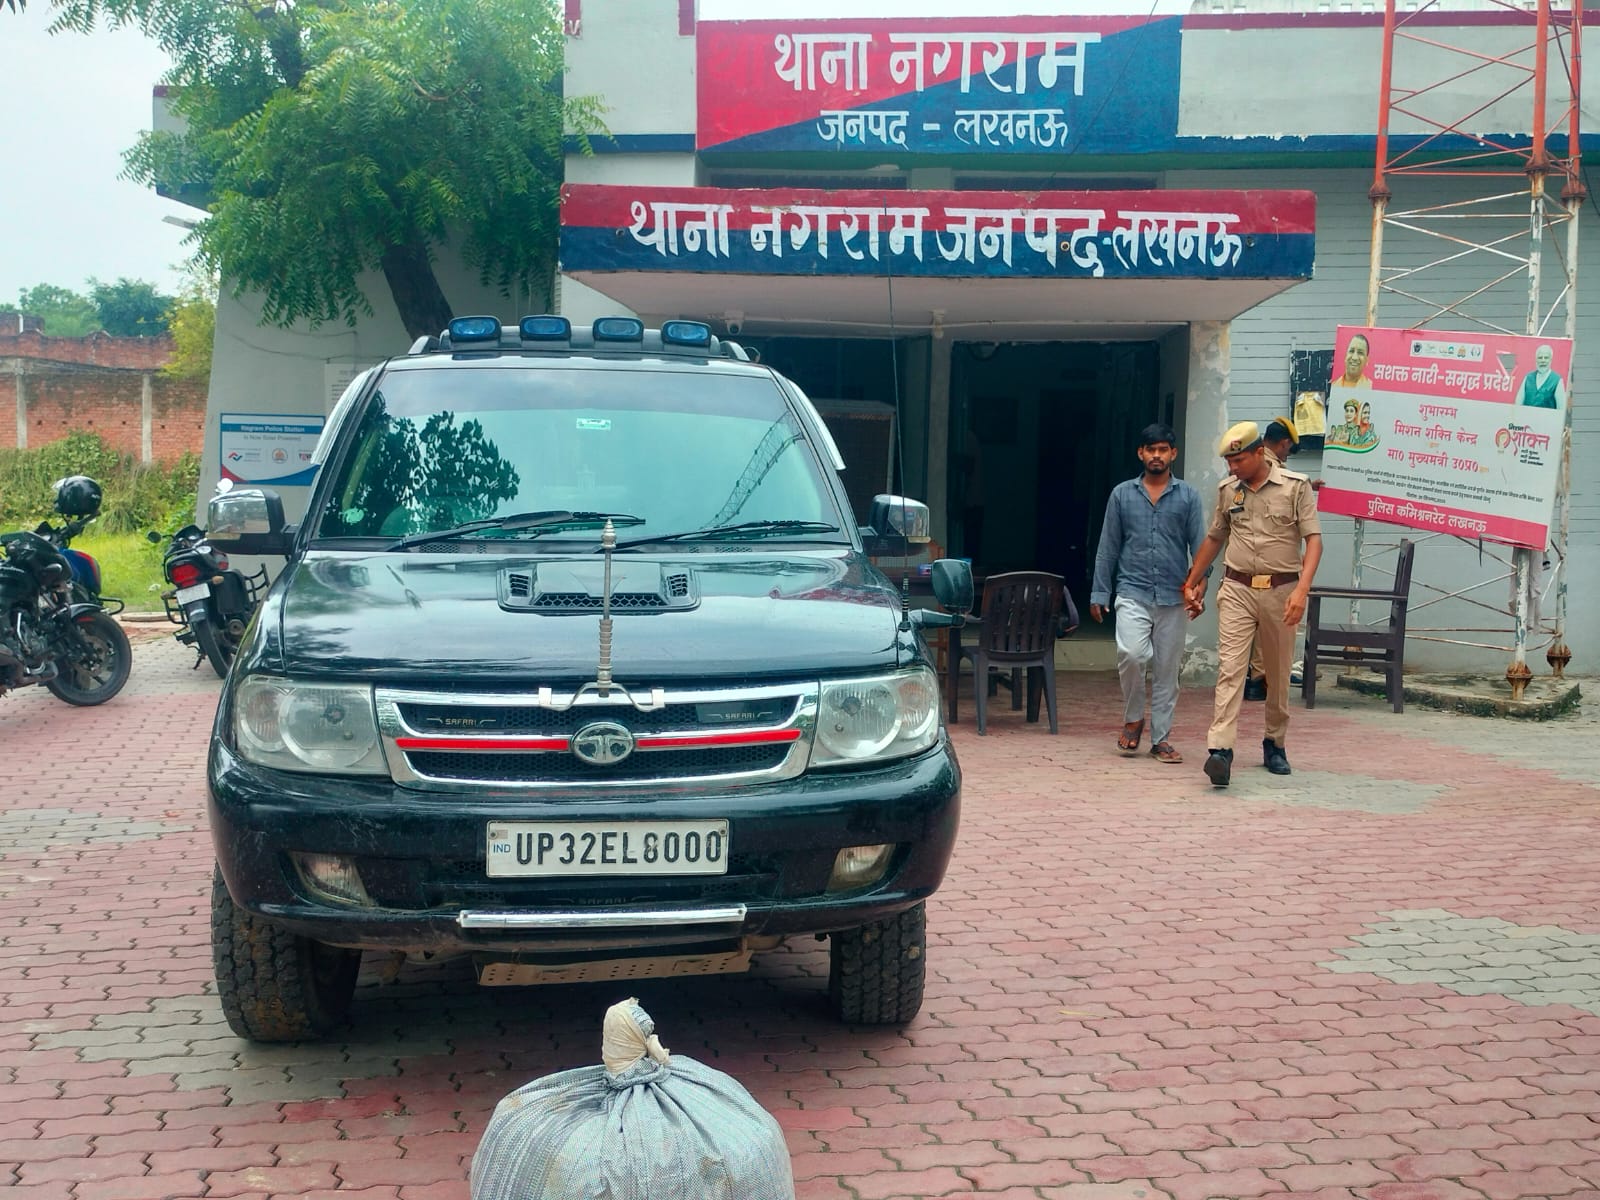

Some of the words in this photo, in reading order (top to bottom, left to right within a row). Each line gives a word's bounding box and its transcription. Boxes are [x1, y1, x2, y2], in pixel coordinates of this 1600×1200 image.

[774, 33, 872, 90] थाना
[889, 33, 1102, 96] नगराम
[817, 110, 910, 151] जनपद
[954, 109, 1068, 147] लखनऊ
[629, 201, 734, 258] थाना
[751, 205, 930, 262] नगराम
[1373, 364, 1410, 382] सशक्त
[1394, 419, 1421, 437] मिशन
[1425, 425, 1452, 441] शक्ति
[1368, 497, 1395, 516] पुलिस
[1448, 514, 1487, 532] लखनऊ
[493, 843, 511, 854] IND
[516, 831, 722, 865] UP32EL8000
